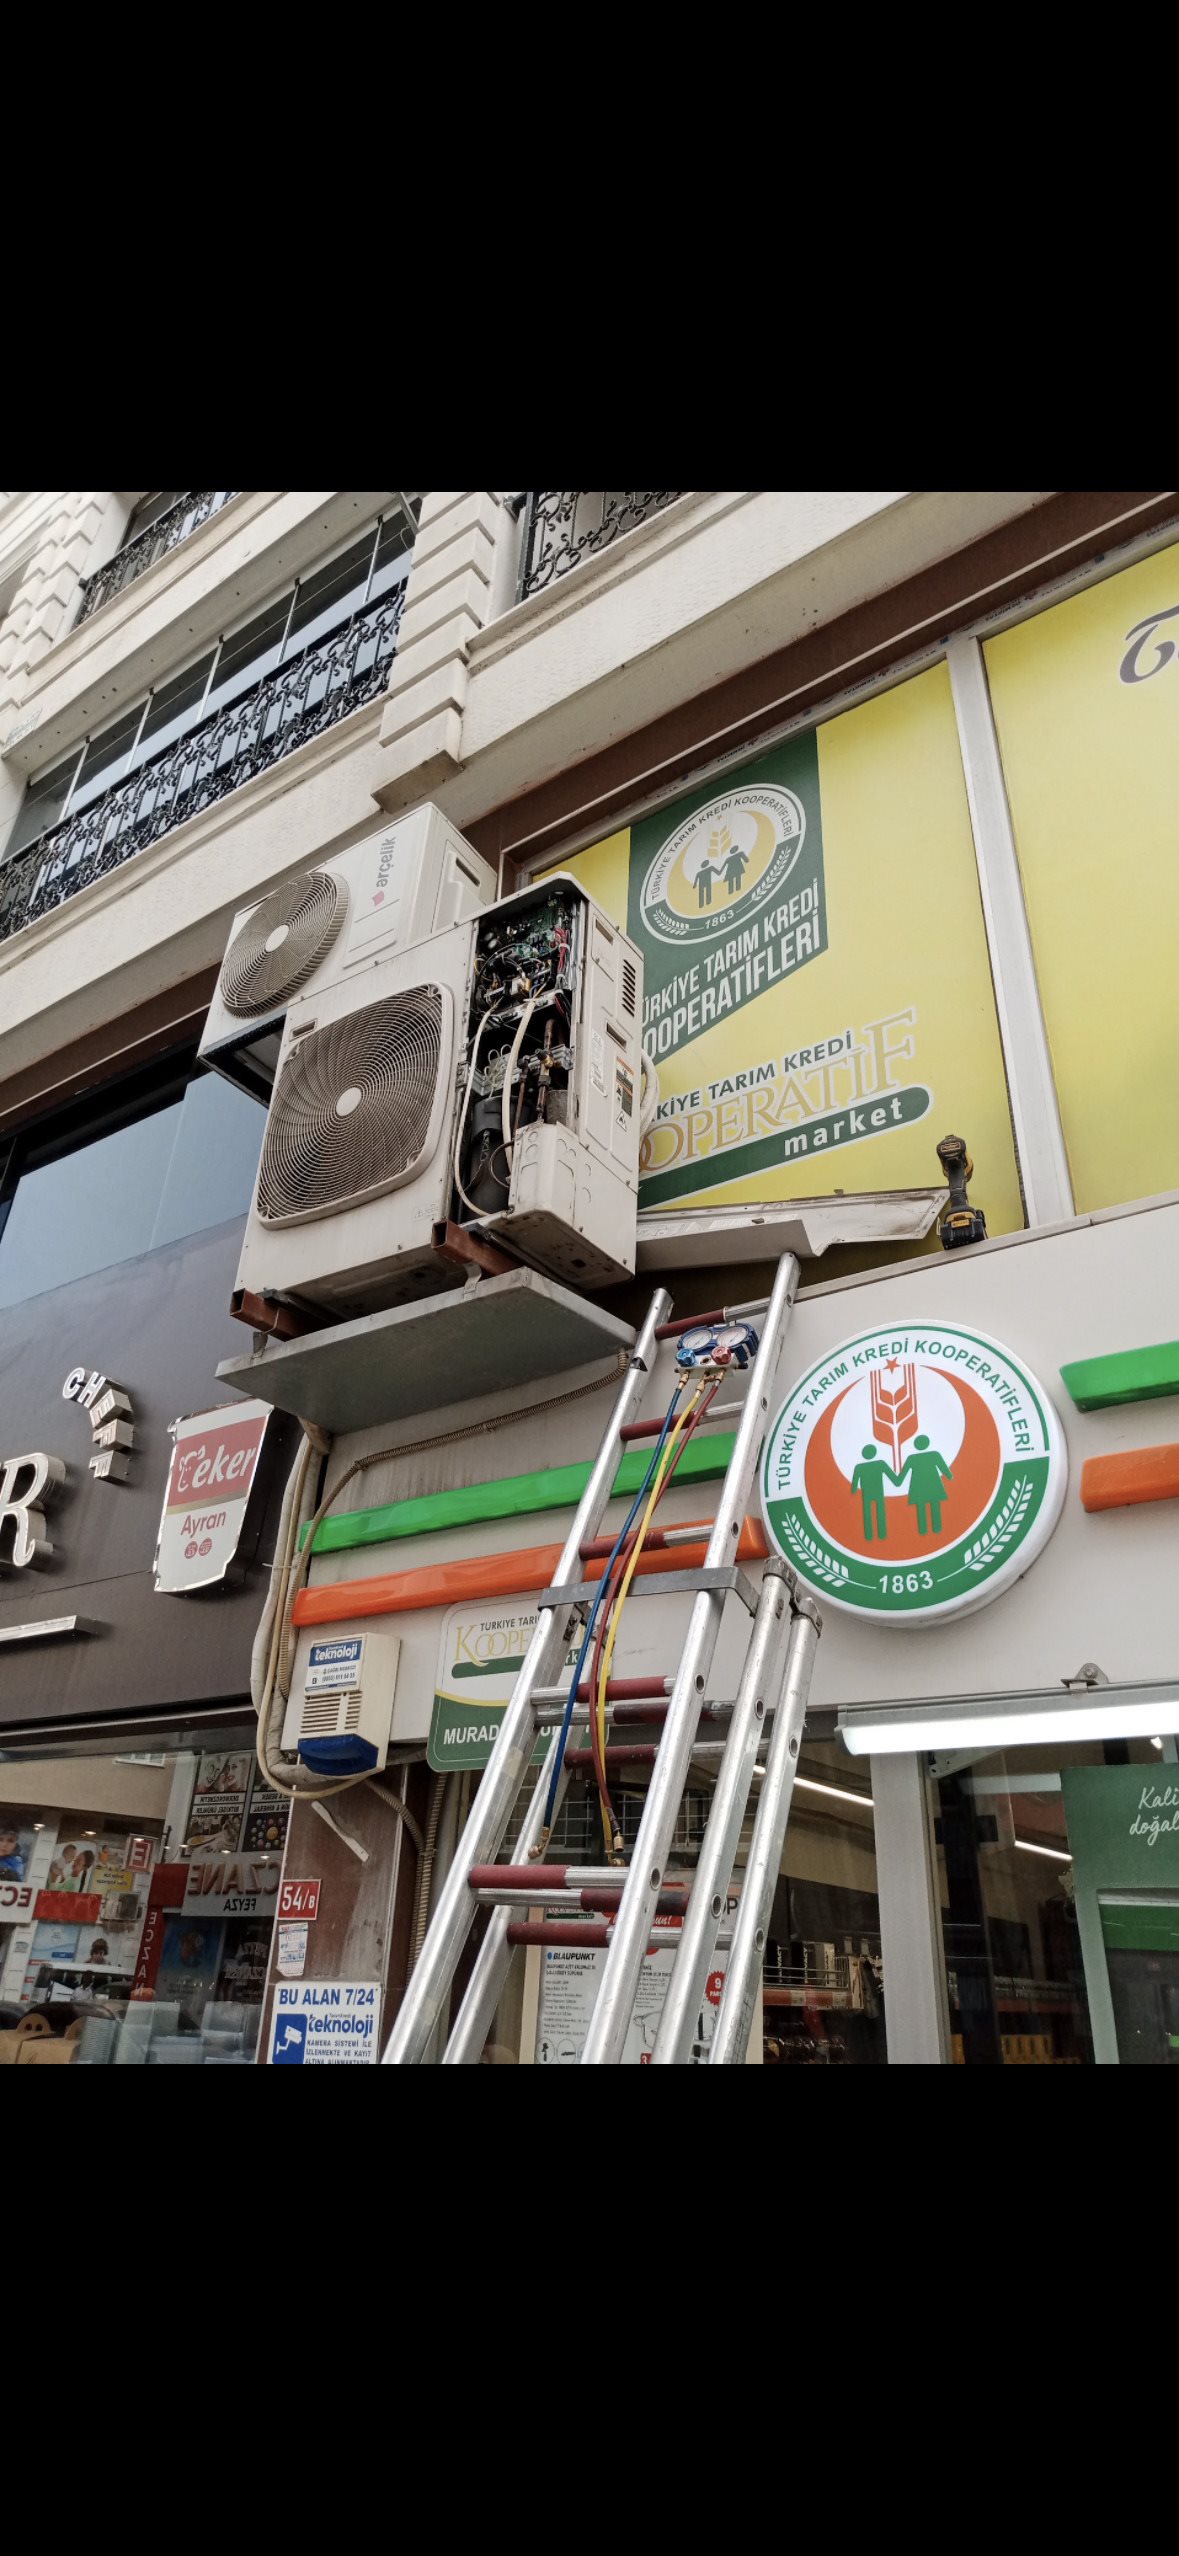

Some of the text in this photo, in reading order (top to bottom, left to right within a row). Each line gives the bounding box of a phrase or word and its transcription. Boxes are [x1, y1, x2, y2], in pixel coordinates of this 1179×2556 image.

[652, 795, 793, 900] TÜRKİYE TARIM KREDİ KOOPERATİFLERİ
[376, 836, 397, 888] arçelik
[705, 909, 735, 930] 1863
[642, 877, 819, 1028] ÜRKİYE TARIM KREDİ
[643, 908, 820, 1060] OOPERATİFLERİ
[709, 1062, 776, 1101] TARIM
[784, 1030, 853, 1073] KREDİ
[785, 1097, 904, 1156] market
[777, 1337, 1035, 1491] TÜRKİYE TARIM KREDİ KOOPERATİFLERİ
[192, 1444, 256, 1489] eker
[181, 1511, 227, 1538] Ayran
[878, 1570, 934, 1595] 1863
[518, 1615, 541, 1627] TARI
[314, 1643, 358, 1661] teknoloji
[443, 1724, 501, 1745] MURAD
[1138, 1786, 1179, 1809] Kali
[1129, 1810, 1179, 1846] doğal
[282, 1885, 315, 1911] 54/B
[553, 1952, 596, 1961] BLAUPUNKT
[714, 1977, 722, 1989] 9
[279, 1988, 375, 2006] BU ALAN 7/24
[308, 2013, 374, 2038] teknoloji
[307, 2039, 331, 2047] KAMERA
